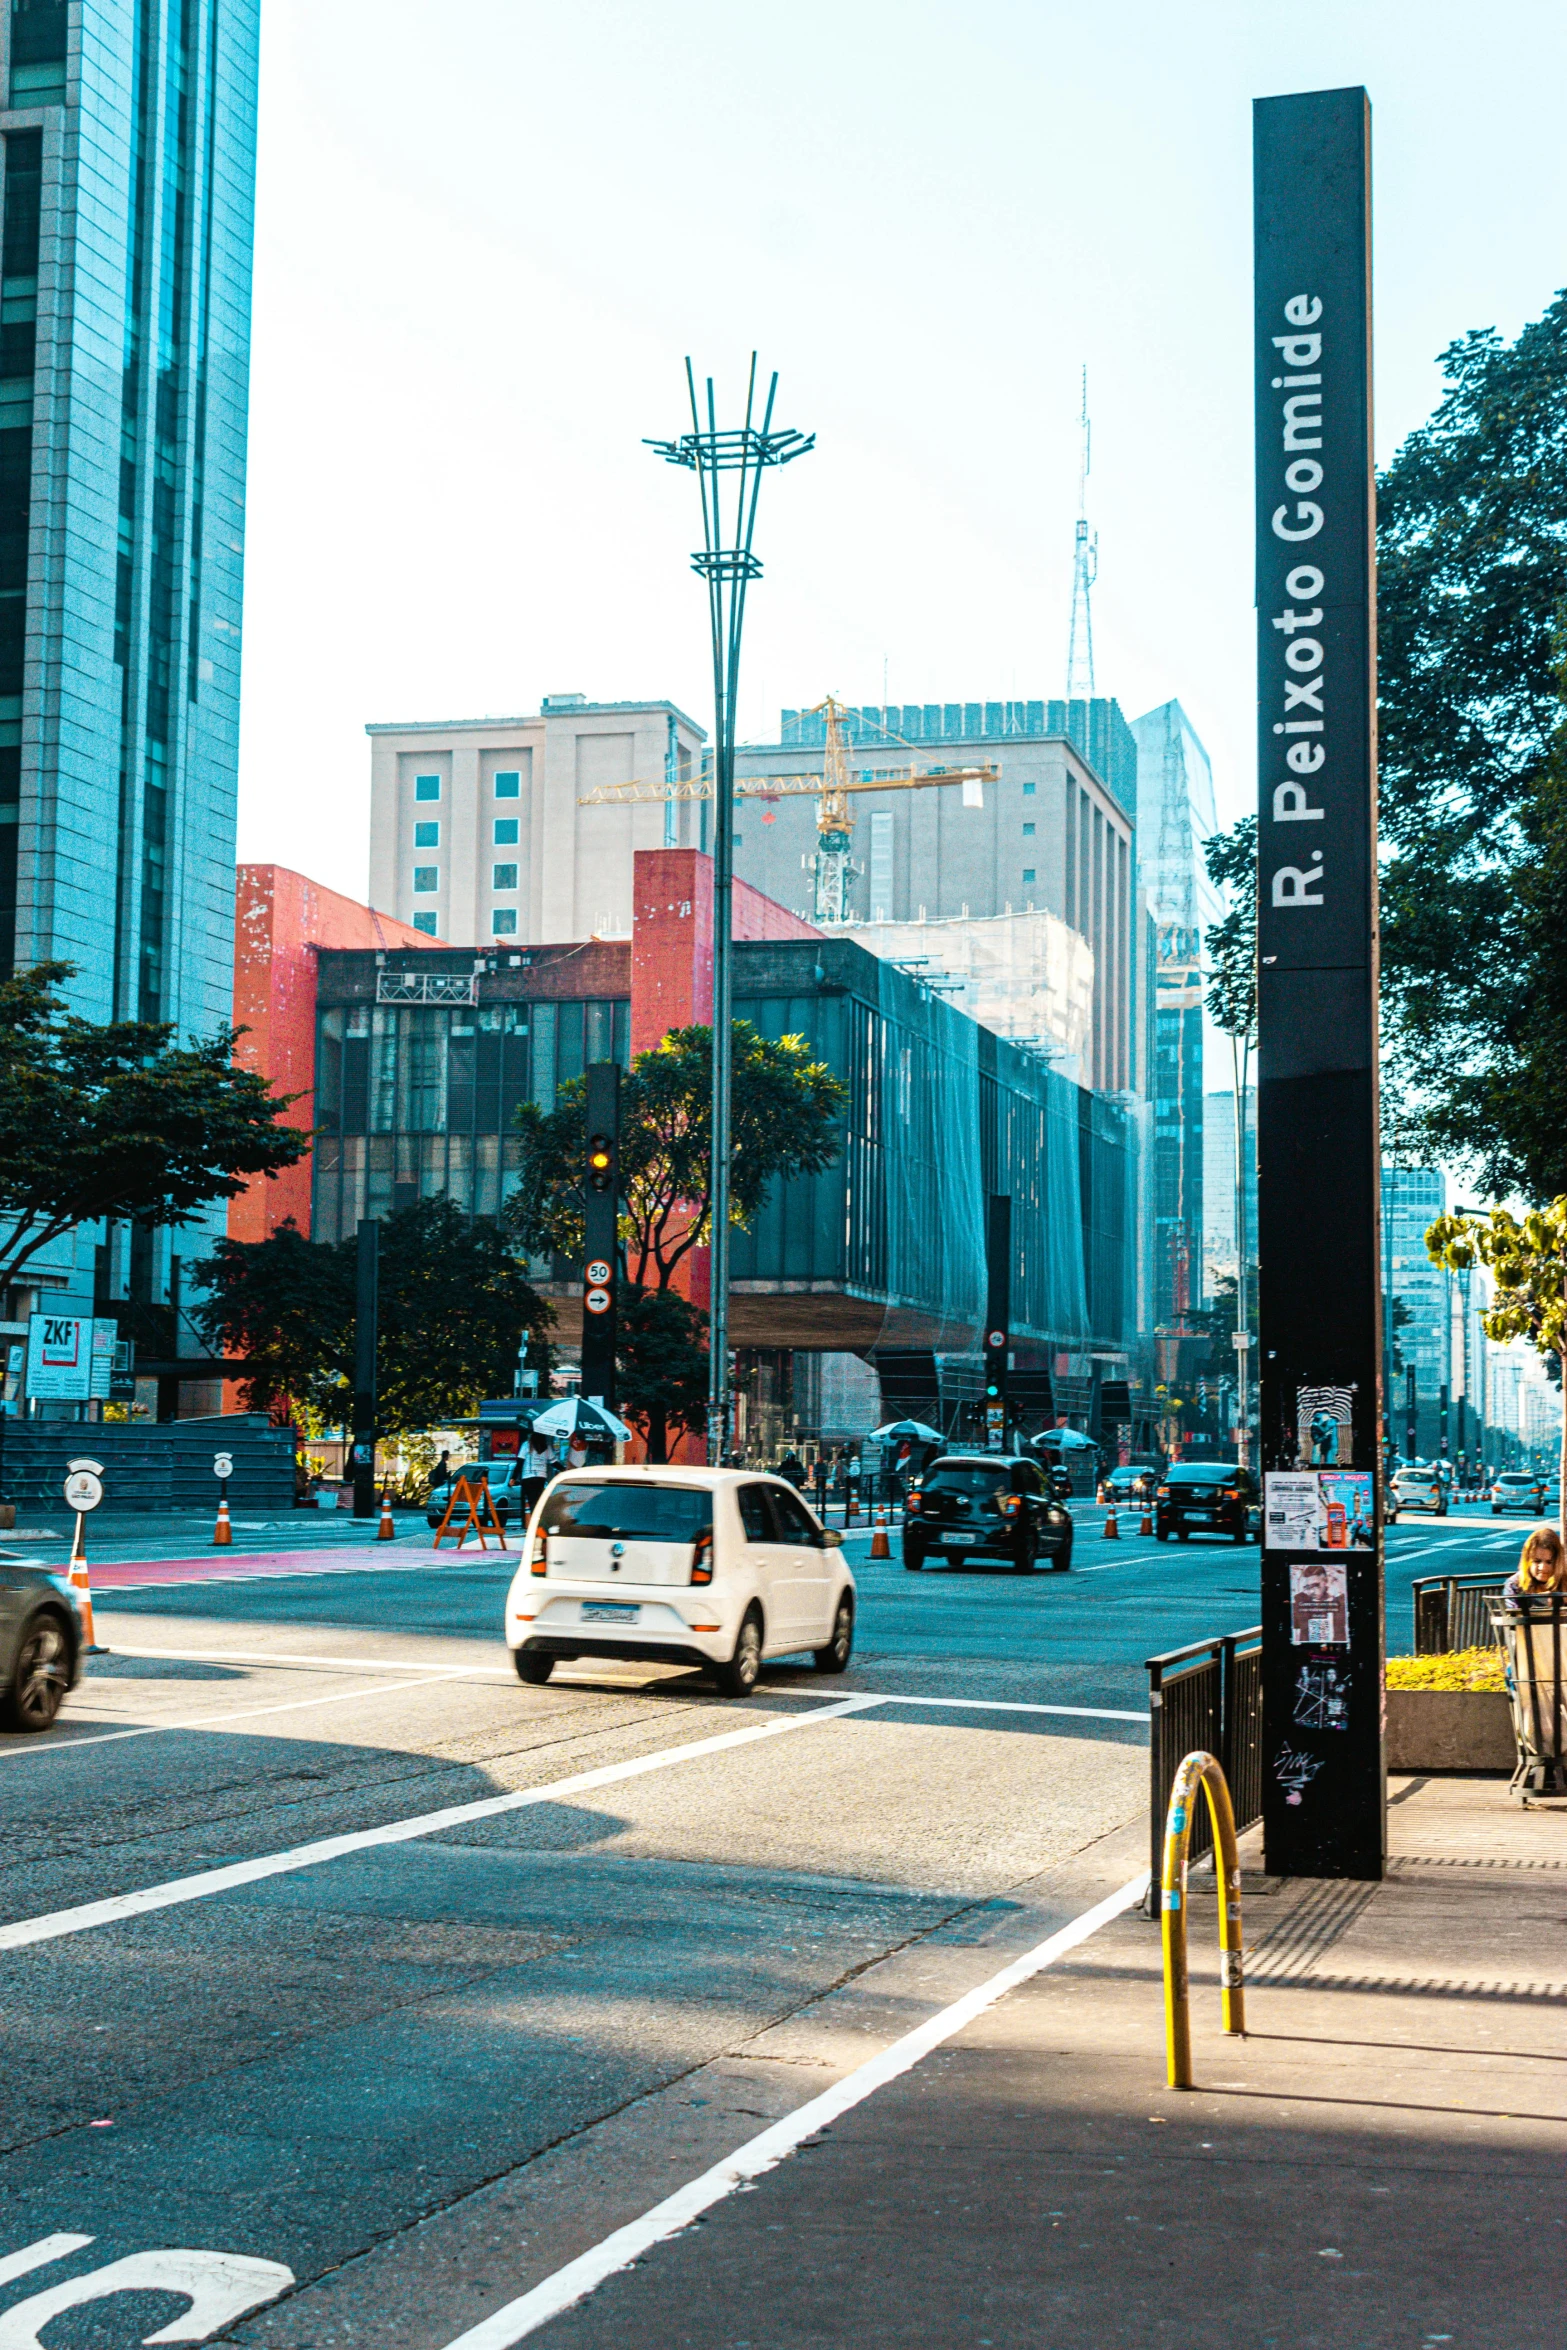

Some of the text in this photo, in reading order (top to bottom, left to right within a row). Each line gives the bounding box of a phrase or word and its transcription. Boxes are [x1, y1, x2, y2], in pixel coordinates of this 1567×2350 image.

[1270, 292, 1326, 908] R. Peixoto Gomide
[590, 1265, 607, 1277] 50
[43, 1319, 72, 1345] ZKF
[578, 1421, 605, 1431] Uber
